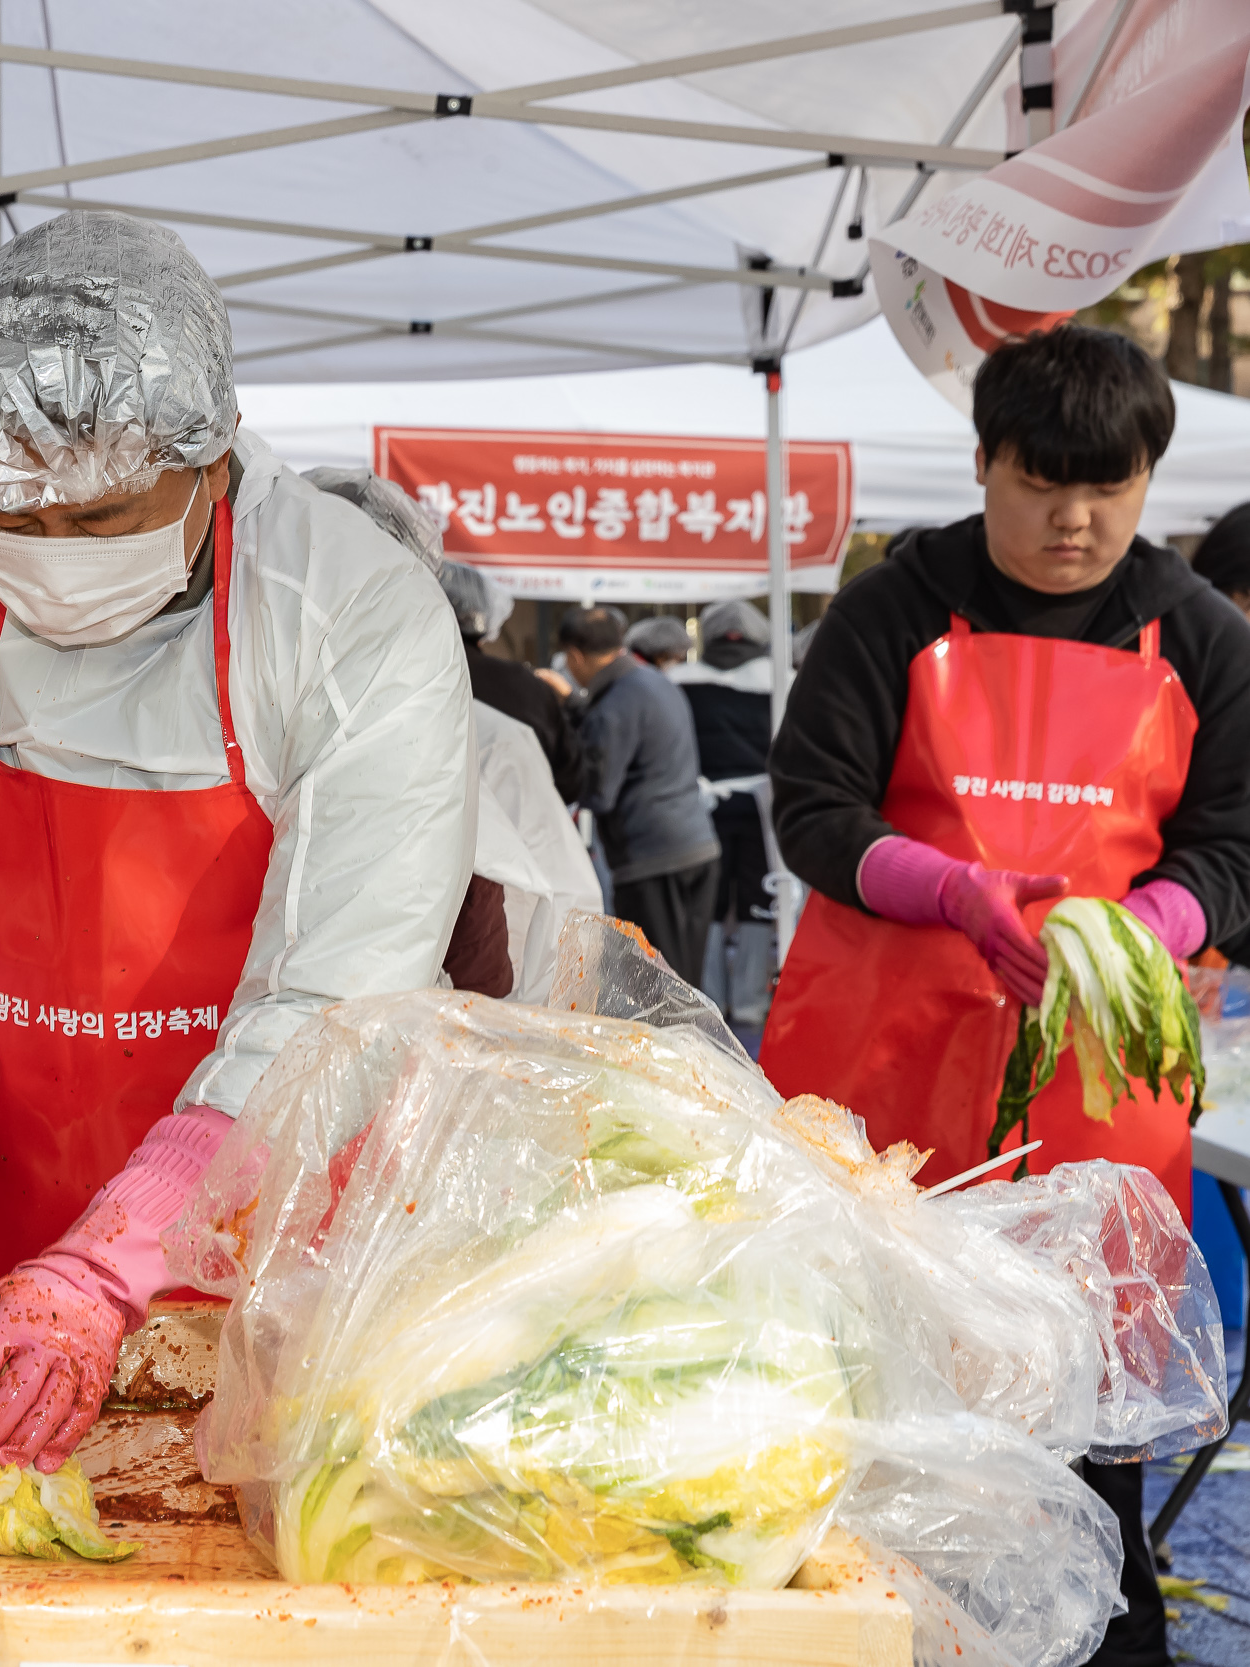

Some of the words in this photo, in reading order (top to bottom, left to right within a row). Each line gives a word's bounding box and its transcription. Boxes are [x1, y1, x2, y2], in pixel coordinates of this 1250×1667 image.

[952, 774, 988, 798] 광진
[990, 779, 1044, 802] 사랑의
[1046, 782, 1114, 807] 김장축제
[35, 1003, 105, 1039] 사랑의
[113, 1004, 219, 1040] 김장축제
